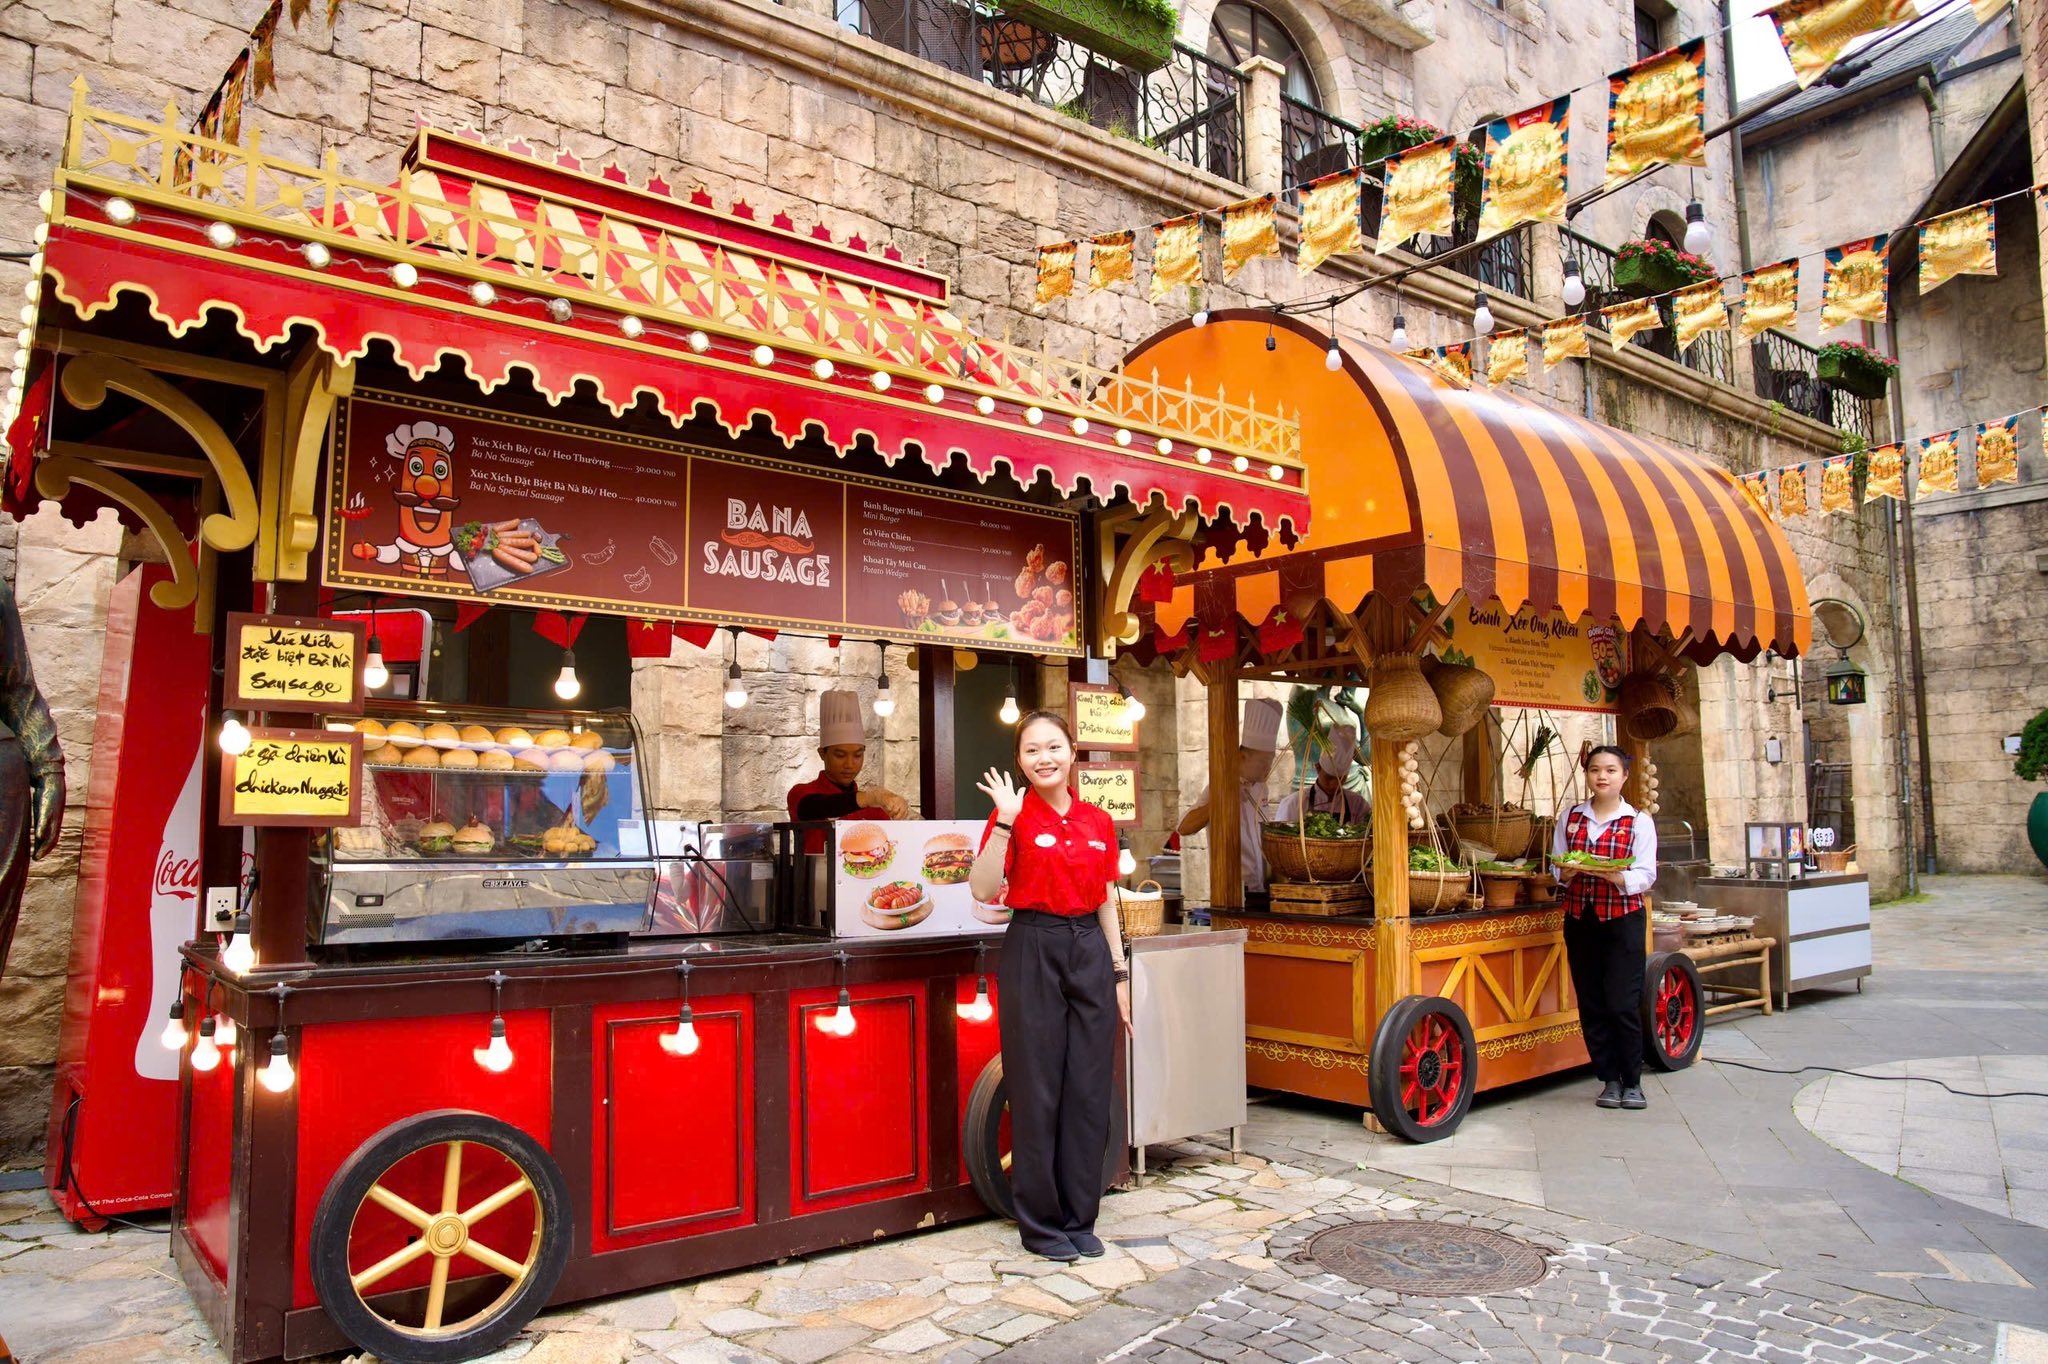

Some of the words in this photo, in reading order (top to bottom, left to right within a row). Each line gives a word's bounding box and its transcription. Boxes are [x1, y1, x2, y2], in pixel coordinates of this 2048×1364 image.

[471, 448, 482, 458] Ba
[484, 451, 498, 460] Na
[500, 453, 534, 468] Sausage
[553, 450, 572, 460] Heo
[572, 453, 610, 468] Thường
[635, 465, 661, 475] 30.000
[470, 480, 482, 490] Ba
[484, 483, 496, 492] Na
[498, 485, 529, 496] Special
[530, 489, 565, 504] Sausage
[599, 488, 618, 498] Heo
[635, 496, 662, 505] 40.000
[882, 504, 906, 515] Burger
[906, 508, 923, 517] Mini
[863, 511, 878, 520] Mini
[879, 514, 900, 524] Burger
[862, 538, 888, 548] Chicken
[889, 542, 915, 552] Nuggets
[863, 555, 884, 564] Khoai
[863, 565, 884, 574] Potato
[116, 1195, 148, 1203] Coca-Cola
